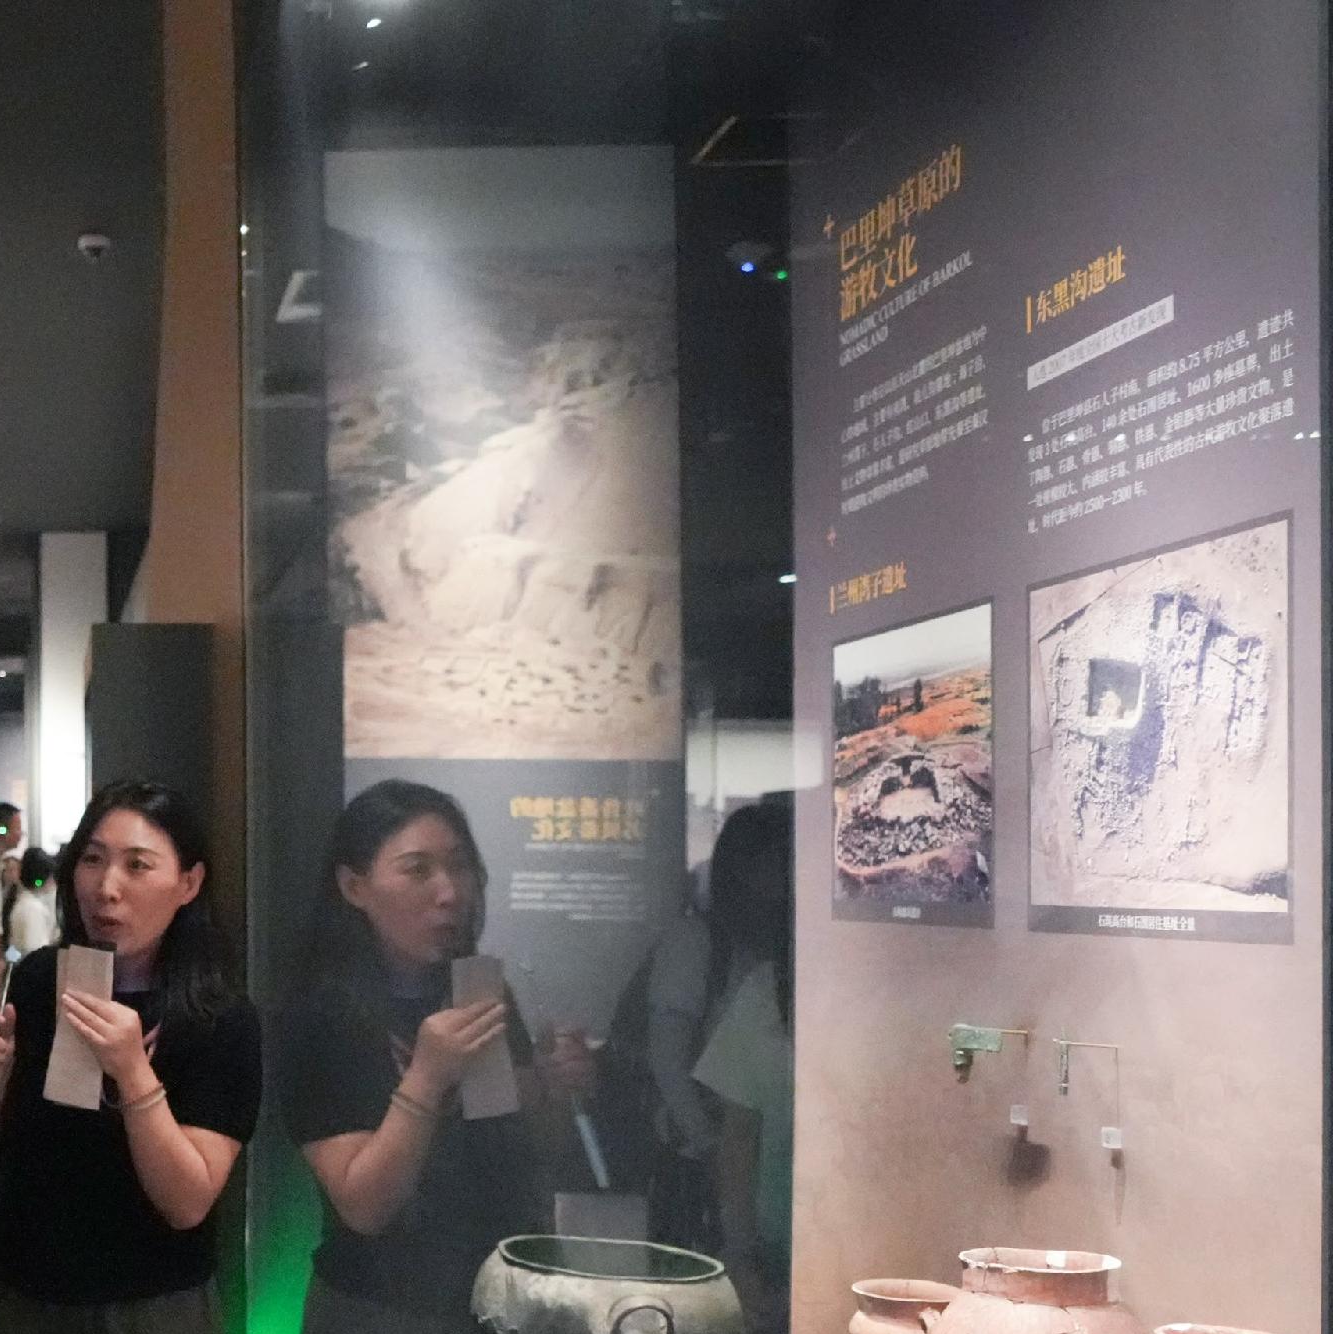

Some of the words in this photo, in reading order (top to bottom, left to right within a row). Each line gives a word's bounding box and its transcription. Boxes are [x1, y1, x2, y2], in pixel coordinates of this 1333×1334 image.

[840, 144, 962, 272] 巴里坤草原的
[840, 233, 918, 322] 游牧文化
[1036, 245, 1126, 324] 东黑沟遗址
